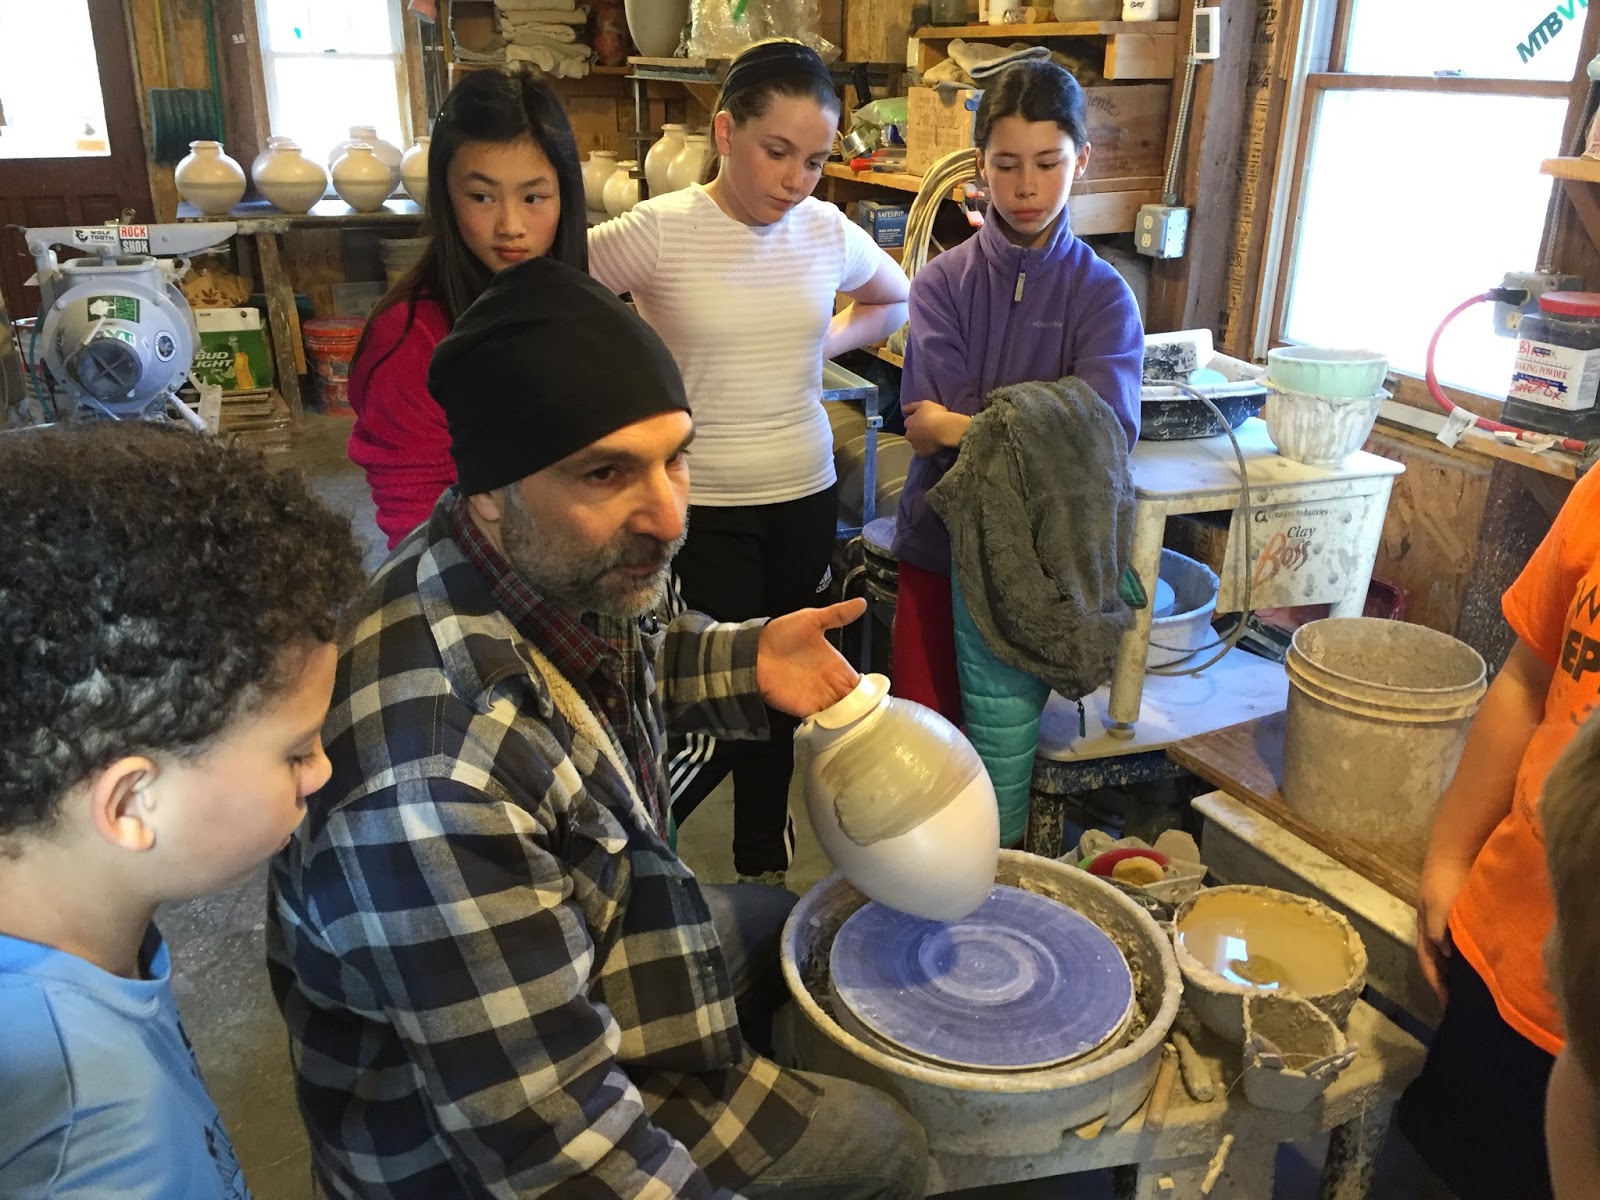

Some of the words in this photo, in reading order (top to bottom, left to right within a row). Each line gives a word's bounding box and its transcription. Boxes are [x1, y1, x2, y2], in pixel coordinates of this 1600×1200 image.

[1516, 0, 1588, 64] MTBV
[877, 210, 905, 218] SAFEGRIP
[121, 226, 146, 238] ROCK
[122, 240, 148, 253] SHOX
[194, 348, 230, 360] BUD
[1539, 366, 1568, 380] POWDER
[1286, 525, 1317, 539] Clay
[1251, 532, 1313, 590] Boss
